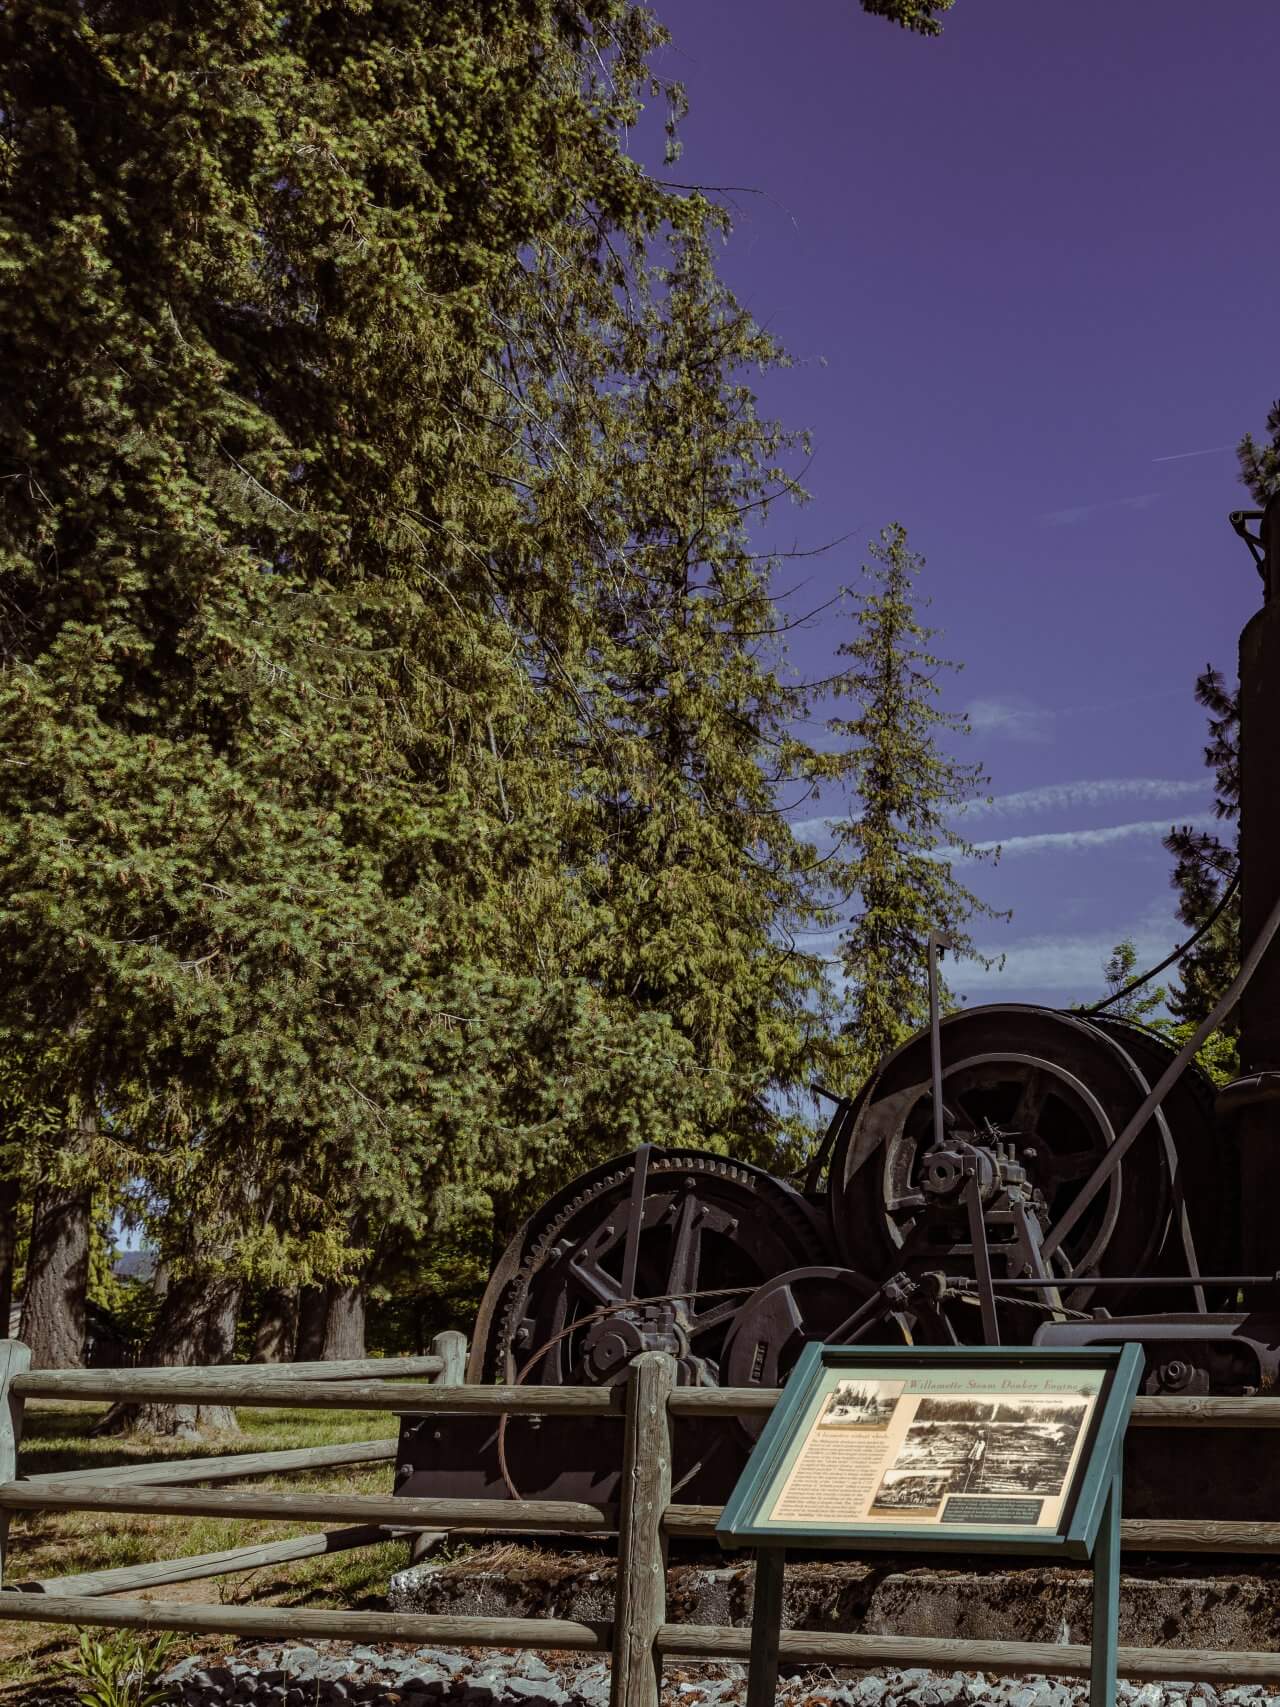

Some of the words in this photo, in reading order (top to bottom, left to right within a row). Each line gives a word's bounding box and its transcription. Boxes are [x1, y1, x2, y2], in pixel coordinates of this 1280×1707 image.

[909, 1377, 963, 1390] Willamette
[967, 1378, 996, 1390] Steam
[1001, 1378, 1038, 1391] Donkey
[1043, 1378, 1077, 1391] Engine
